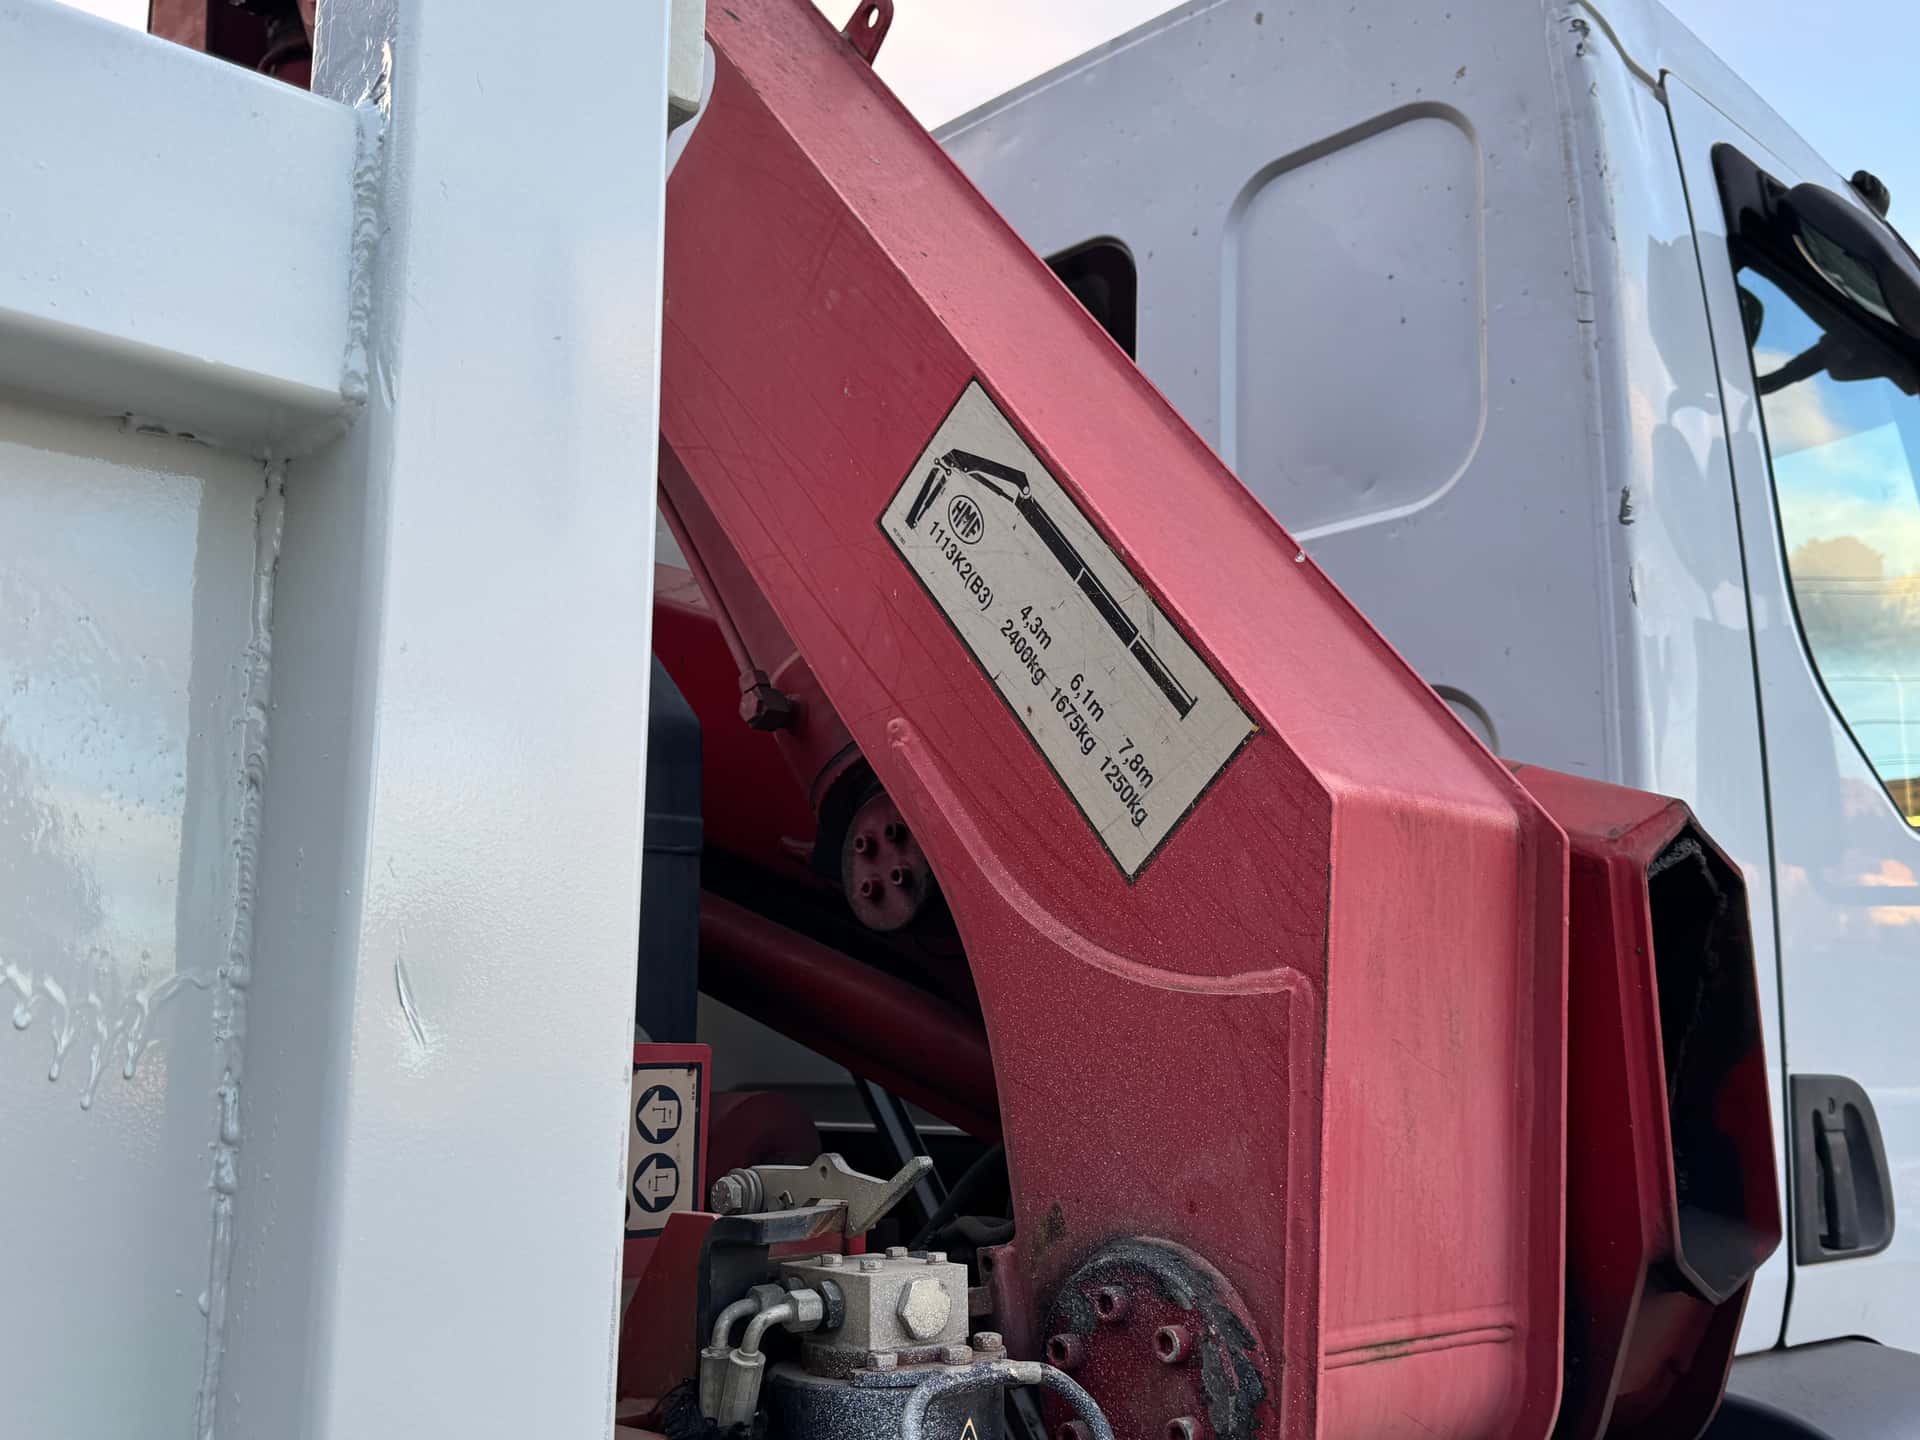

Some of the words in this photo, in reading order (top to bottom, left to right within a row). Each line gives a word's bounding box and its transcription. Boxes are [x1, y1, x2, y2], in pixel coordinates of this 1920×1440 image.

[929, 521, 994, 612] 1113K2(B3)
[951, 499, 981, 539] HMF
[1000, 619, 1046, 686] 2400kg
[1050, 687, 1097, 755] 1675kg
[1099, 756, 1148, 827] 1250kg
[1020, 604, 1051, 649] 4,3m
[1070, 673, 1104, 722] 6,1m
[1119, 737, 1154, 789] 7,8m
